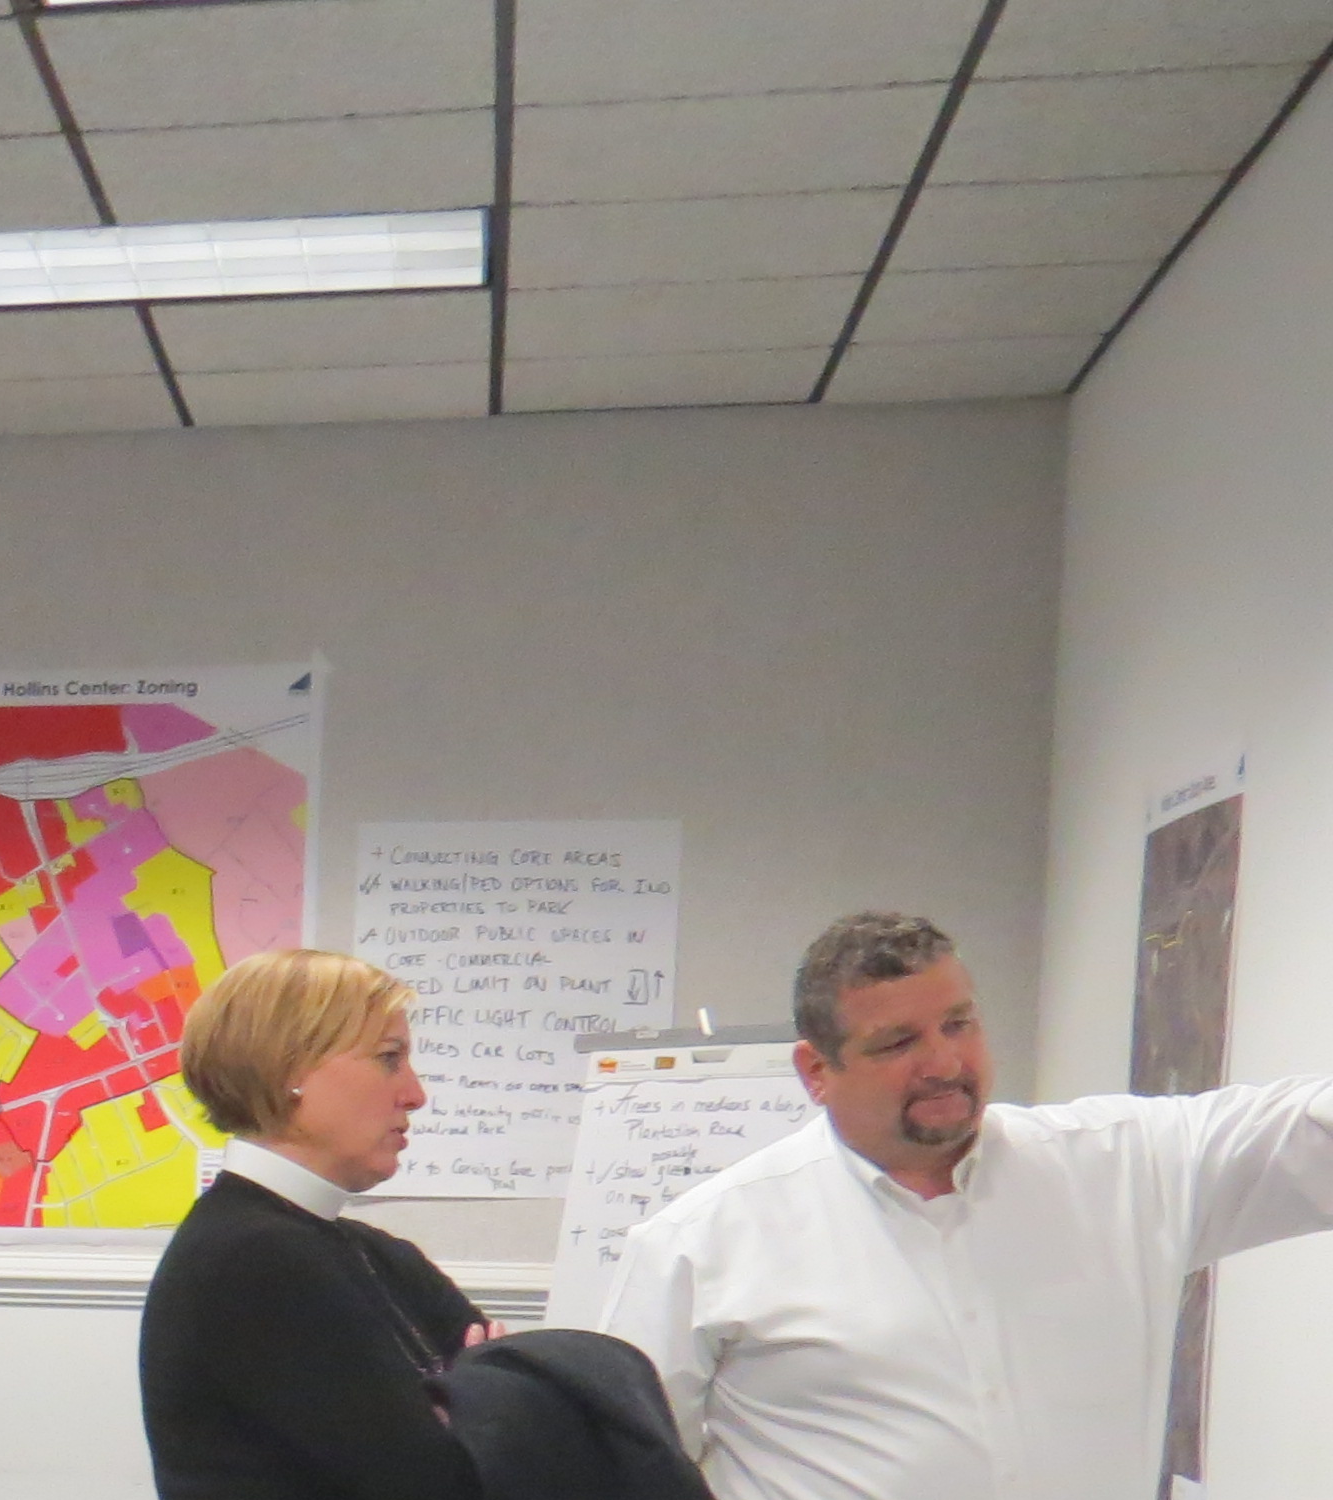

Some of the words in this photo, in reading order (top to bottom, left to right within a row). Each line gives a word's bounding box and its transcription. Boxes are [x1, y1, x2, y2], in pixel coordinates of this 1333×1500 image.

[3, 682, 59, 697] Hollins
[136, 679, 198, 697] Zoning
[509, 847, 552, 866] CORE
[562, 848, 623, 868] AREAS
[510, 877, 579, 893] OPTIONS
[591, 877, 625, 893] FOR
[389, 901, 486, 916] PROPERTIES
[496, 901, 518, 914] TO
[527, 898, 576, 915] PARK
[386, 926, 462, 945] OUTDOOR
[475, 925, 537, 943] PUBLIC
[626, 928, 647, 943] IN
[385, 952, 427, 969] CORE
[445, 951, 554, 970] COMMERCIAL
[453, 976, 511, 994] LIMIT
[523, 978, 548, 993] ON
[409, 1005, 464, 1027] AFFIC
[474, 1008, 533, 1029] LIGHT
[542, 1010, 619, 1034] CONTROL
[417, 1036, 460, 1058] USED
[471, 1041, 504, 1059] CAR
[516, 1044, 556, 1066] LOTS
[759, 1095, 808, 1123] along
